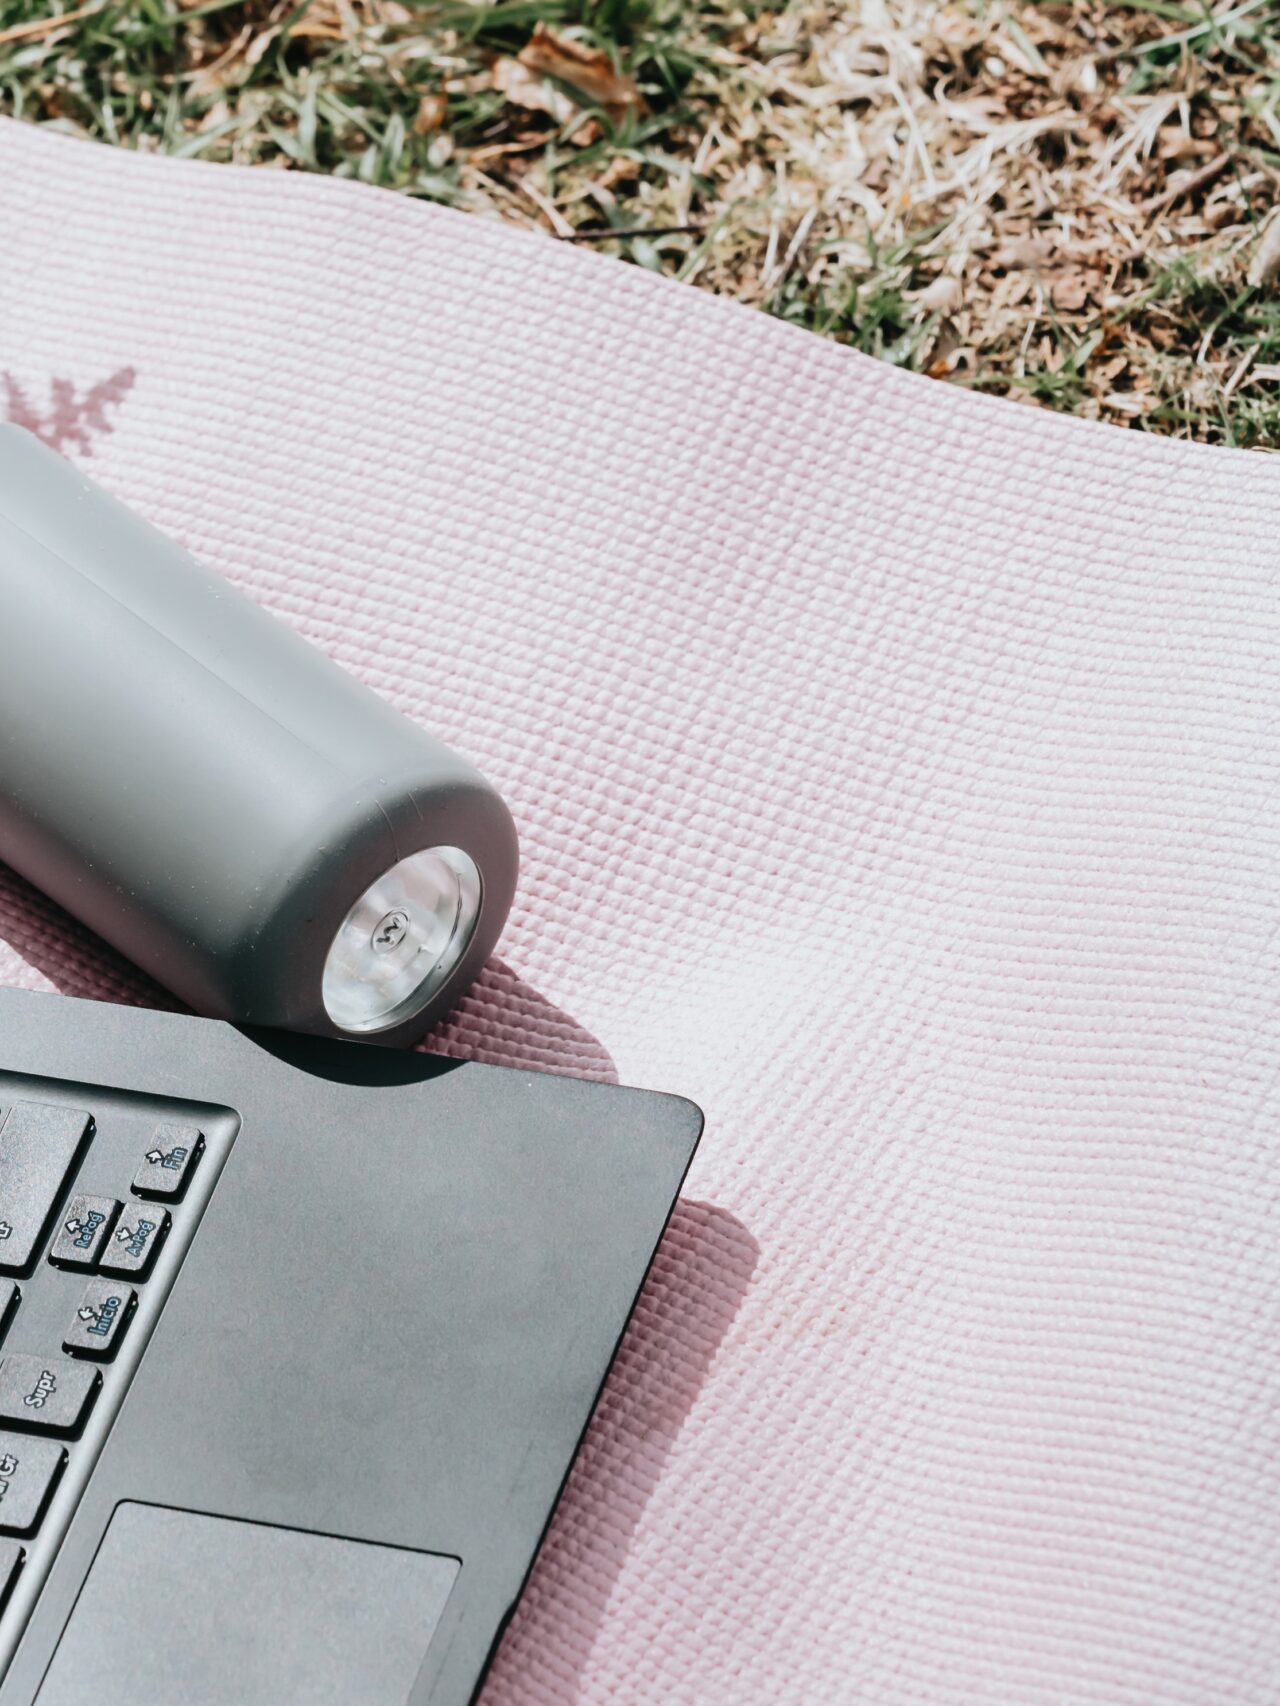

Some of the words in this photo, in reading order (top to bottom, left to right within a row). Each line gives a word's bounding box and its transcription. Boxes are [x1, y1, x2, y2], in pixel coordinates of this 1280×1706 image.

[164, 1148, 186, 1169] Fin
[75, 1211, 105, 1248] RePág
[126, 1220, 155, 1257] AvPág
[88, 1297, 120, 1336] Inicio
[23, 1370, 56, 1409] Supr
